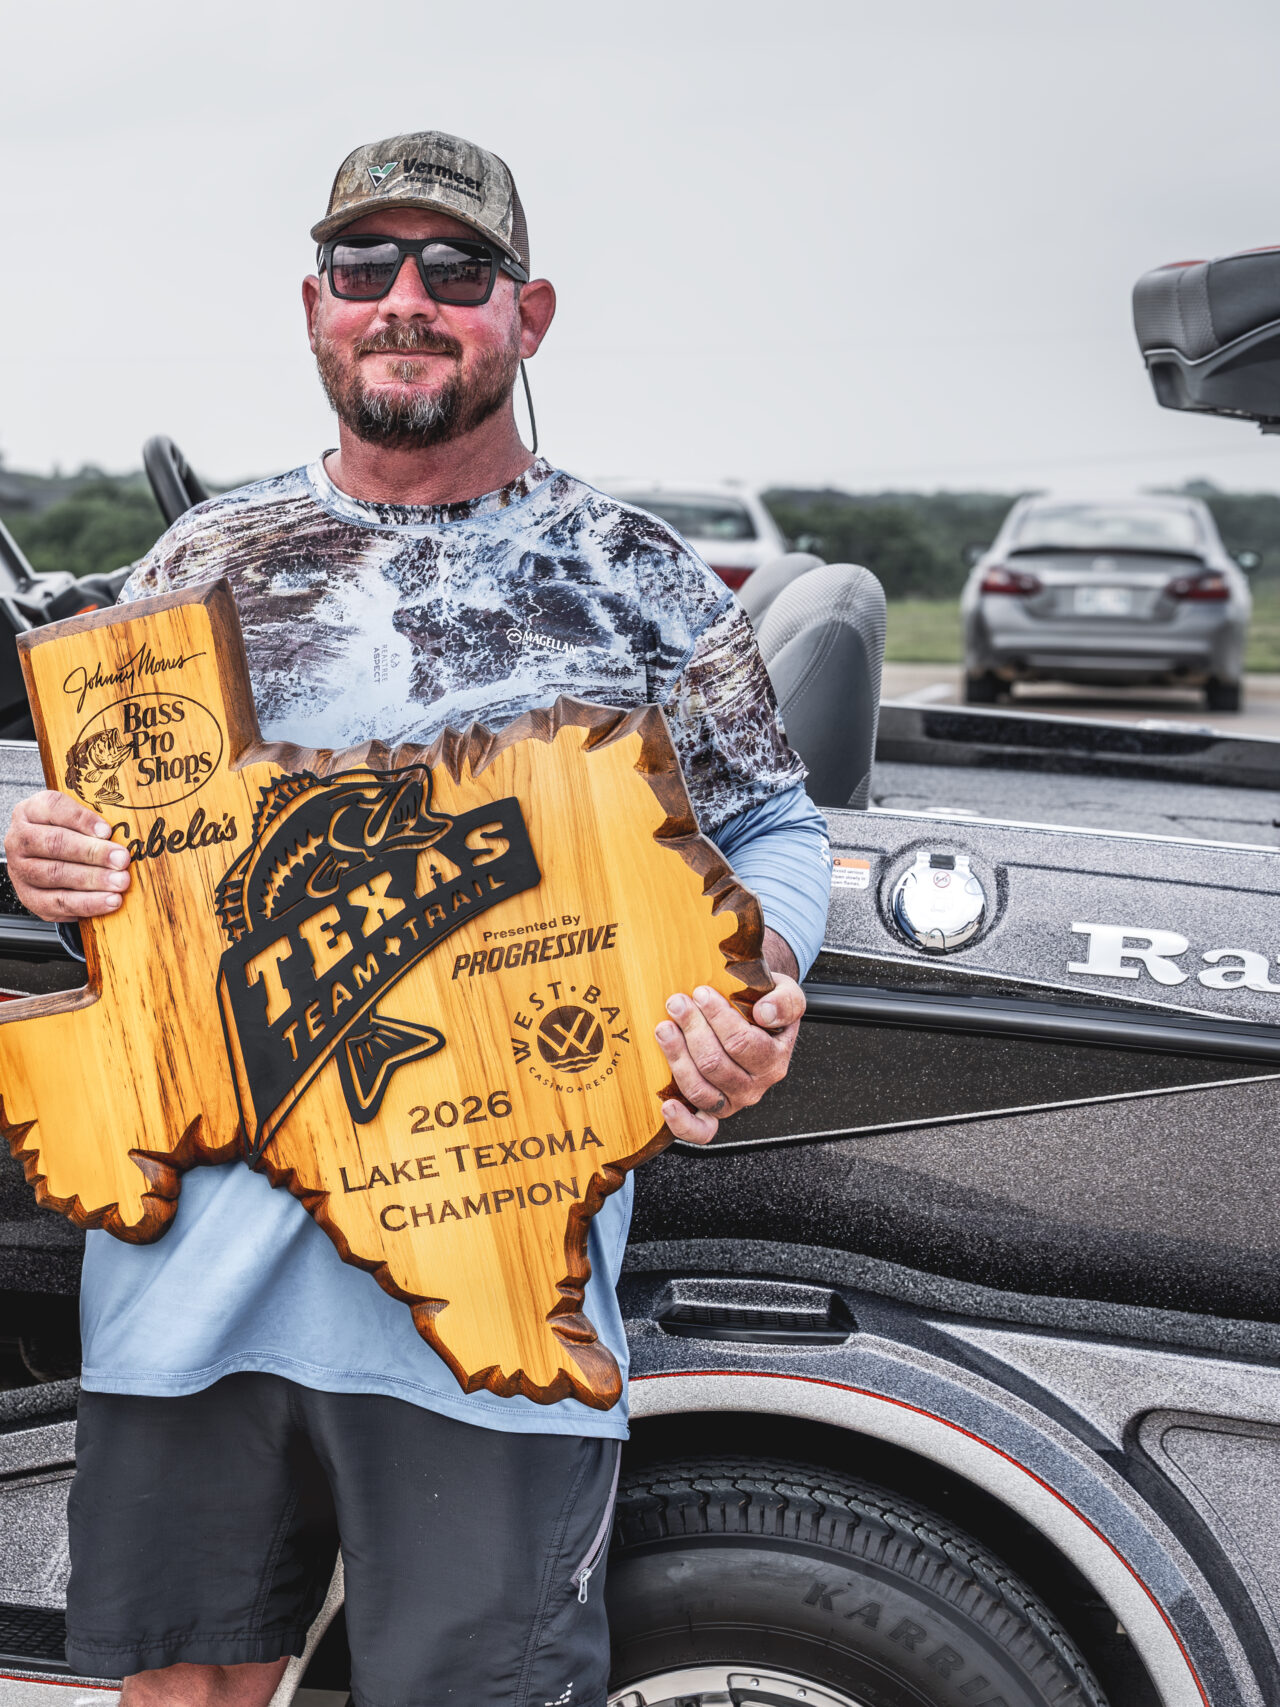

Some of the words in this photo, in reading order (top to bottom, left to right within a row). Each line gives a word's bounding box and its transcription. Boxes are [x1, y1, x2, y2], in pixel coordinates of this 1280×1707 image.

[403, 158, 482, 192] Vermeer
[373, 647, 381, 684] ASPECT
[523, 631, 578, 655] MAGELLAN
[63, 662, 134, 714] Johnny
[123, 700, 185, 733] Bass
[132, 730, 174, 760] Pro
[244, 820, 511, 1027] TEXAS
[482, 917, 557, 942] Presented
[562, 913, 581, 930] By
[282, 956, 380, 1061] TEAM
[402, 877, 507, 941] TRAIL
[451, 923, 619, 980] PROGRESSIVE
[1067, 922, 1280, 993] Ra
[408, 1090, 513, 1135] 2026
[338, 1155, 440, 1194] LAKE
[445, 1126, 605, 1173] TEXOMA
[379, 1176, 581, 1232] CHAMPION
[802, 1582, 1008, 1707] KARRI
